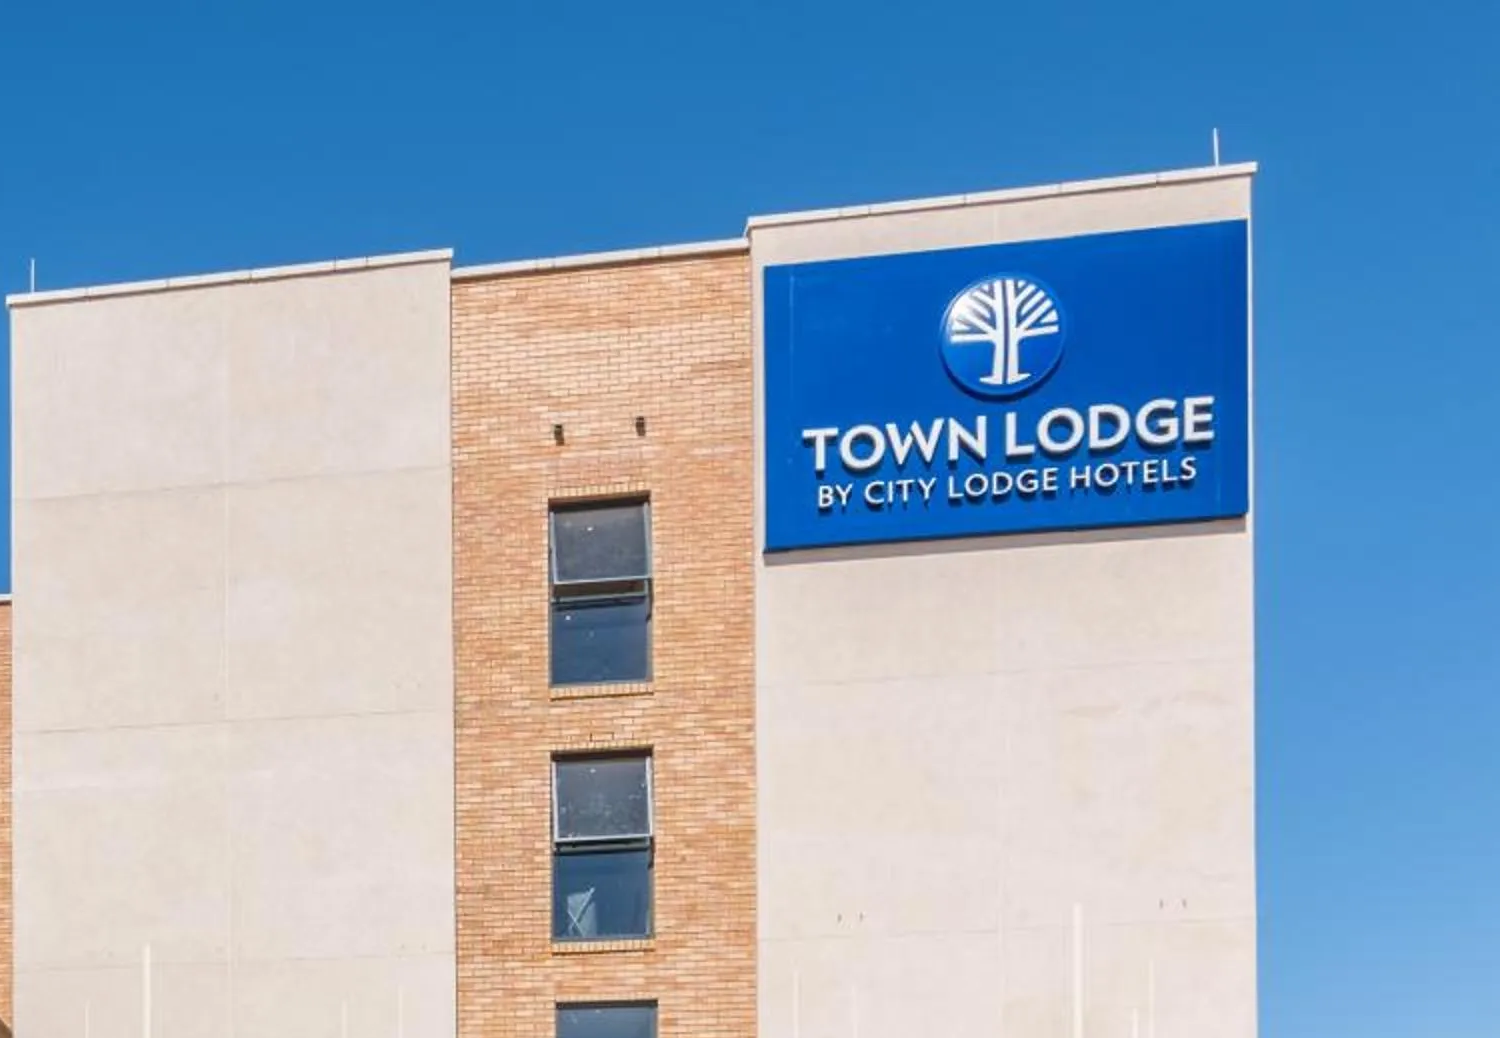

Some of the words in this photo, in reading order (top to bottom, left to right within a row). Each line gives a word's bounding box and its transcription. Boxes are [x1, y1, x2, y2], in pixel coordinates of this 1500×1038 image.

[802, 414, 987, 472] TOWN
[1005, 396, 1216, 456] LODGE
[819, 484, 853, 509] BY
[864, 477, 937, 506] CITY
[948, 466, 1058, 499] LODGE
[1070, 456, 1198, 491] HOTELS
